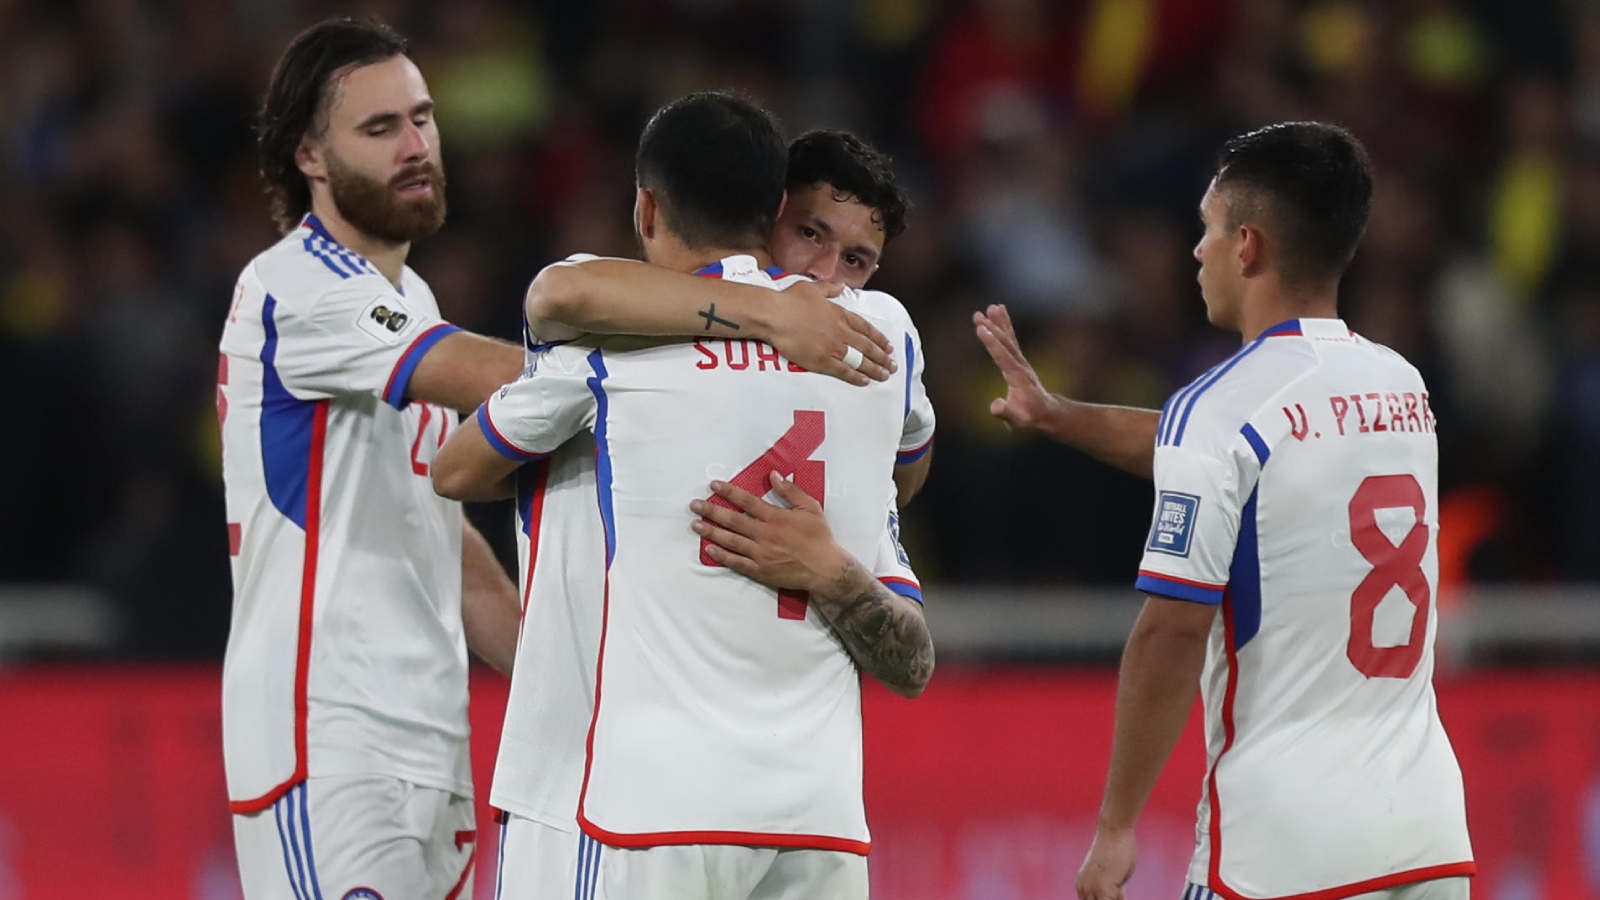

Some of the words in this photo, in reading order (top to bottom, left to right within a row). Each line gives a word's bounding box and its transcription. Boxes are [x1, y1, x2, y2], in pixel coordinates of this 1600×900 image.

[694, 336, 809, 373] SUA
[1282, 404, 1322, 443] V.
[1329, 392, 1435, 437] PIZARR
[699, 410, 826, 621] 4
[1160, 511, 1187, 525] UNITES
[1346, 474, 1431, 680] 8
